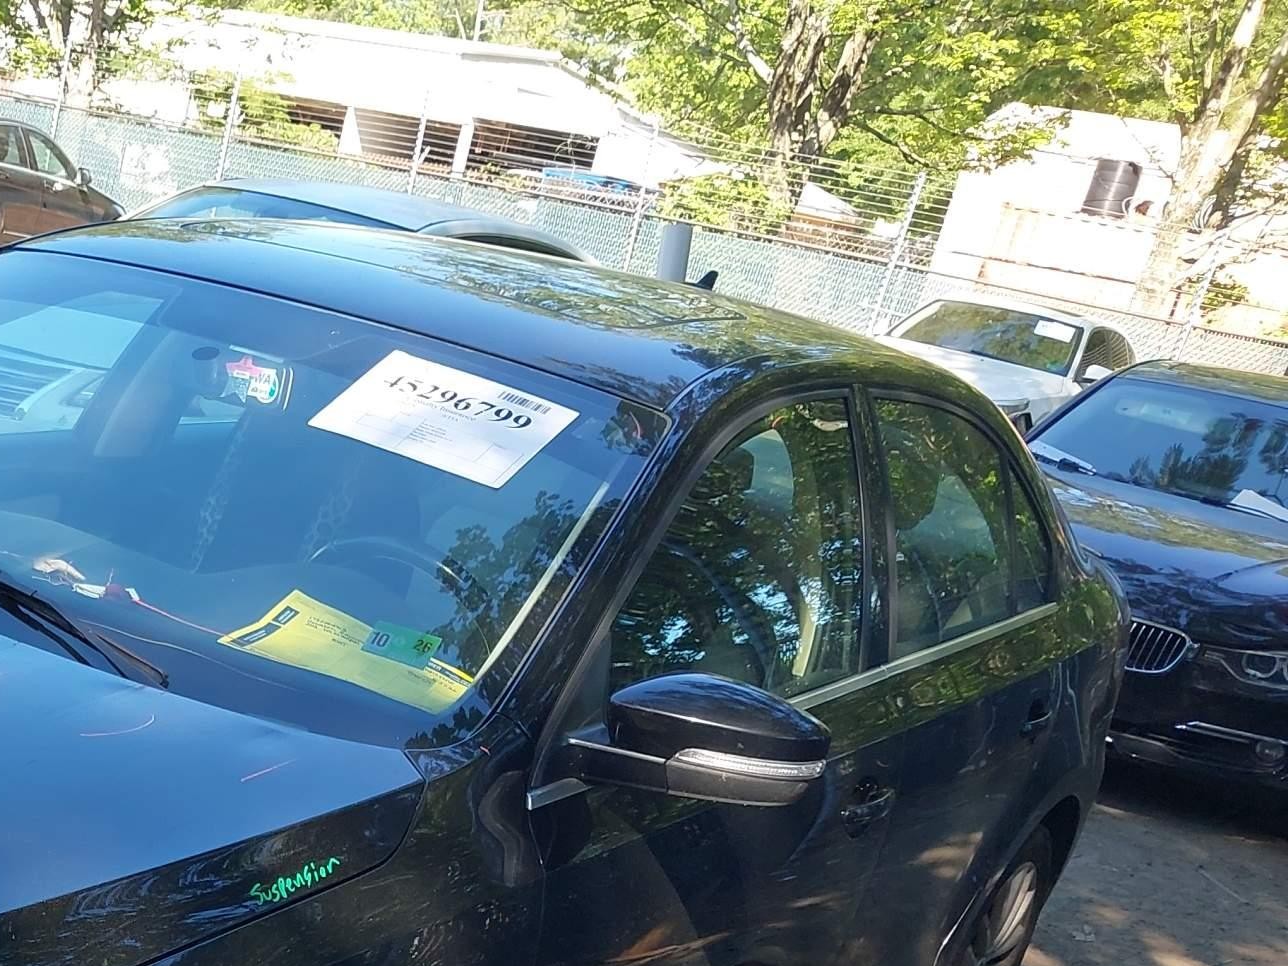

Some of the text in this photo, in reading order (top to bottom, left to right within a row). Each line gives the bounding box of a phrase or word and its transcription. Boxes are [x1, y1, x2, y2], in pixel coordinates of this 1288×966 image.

[383, 375, 532, 429] 45296799
[371, 631, 390, 648] 10
[414, 639, 433, 654] 26
[249, 857, 341, 906] Suspension
